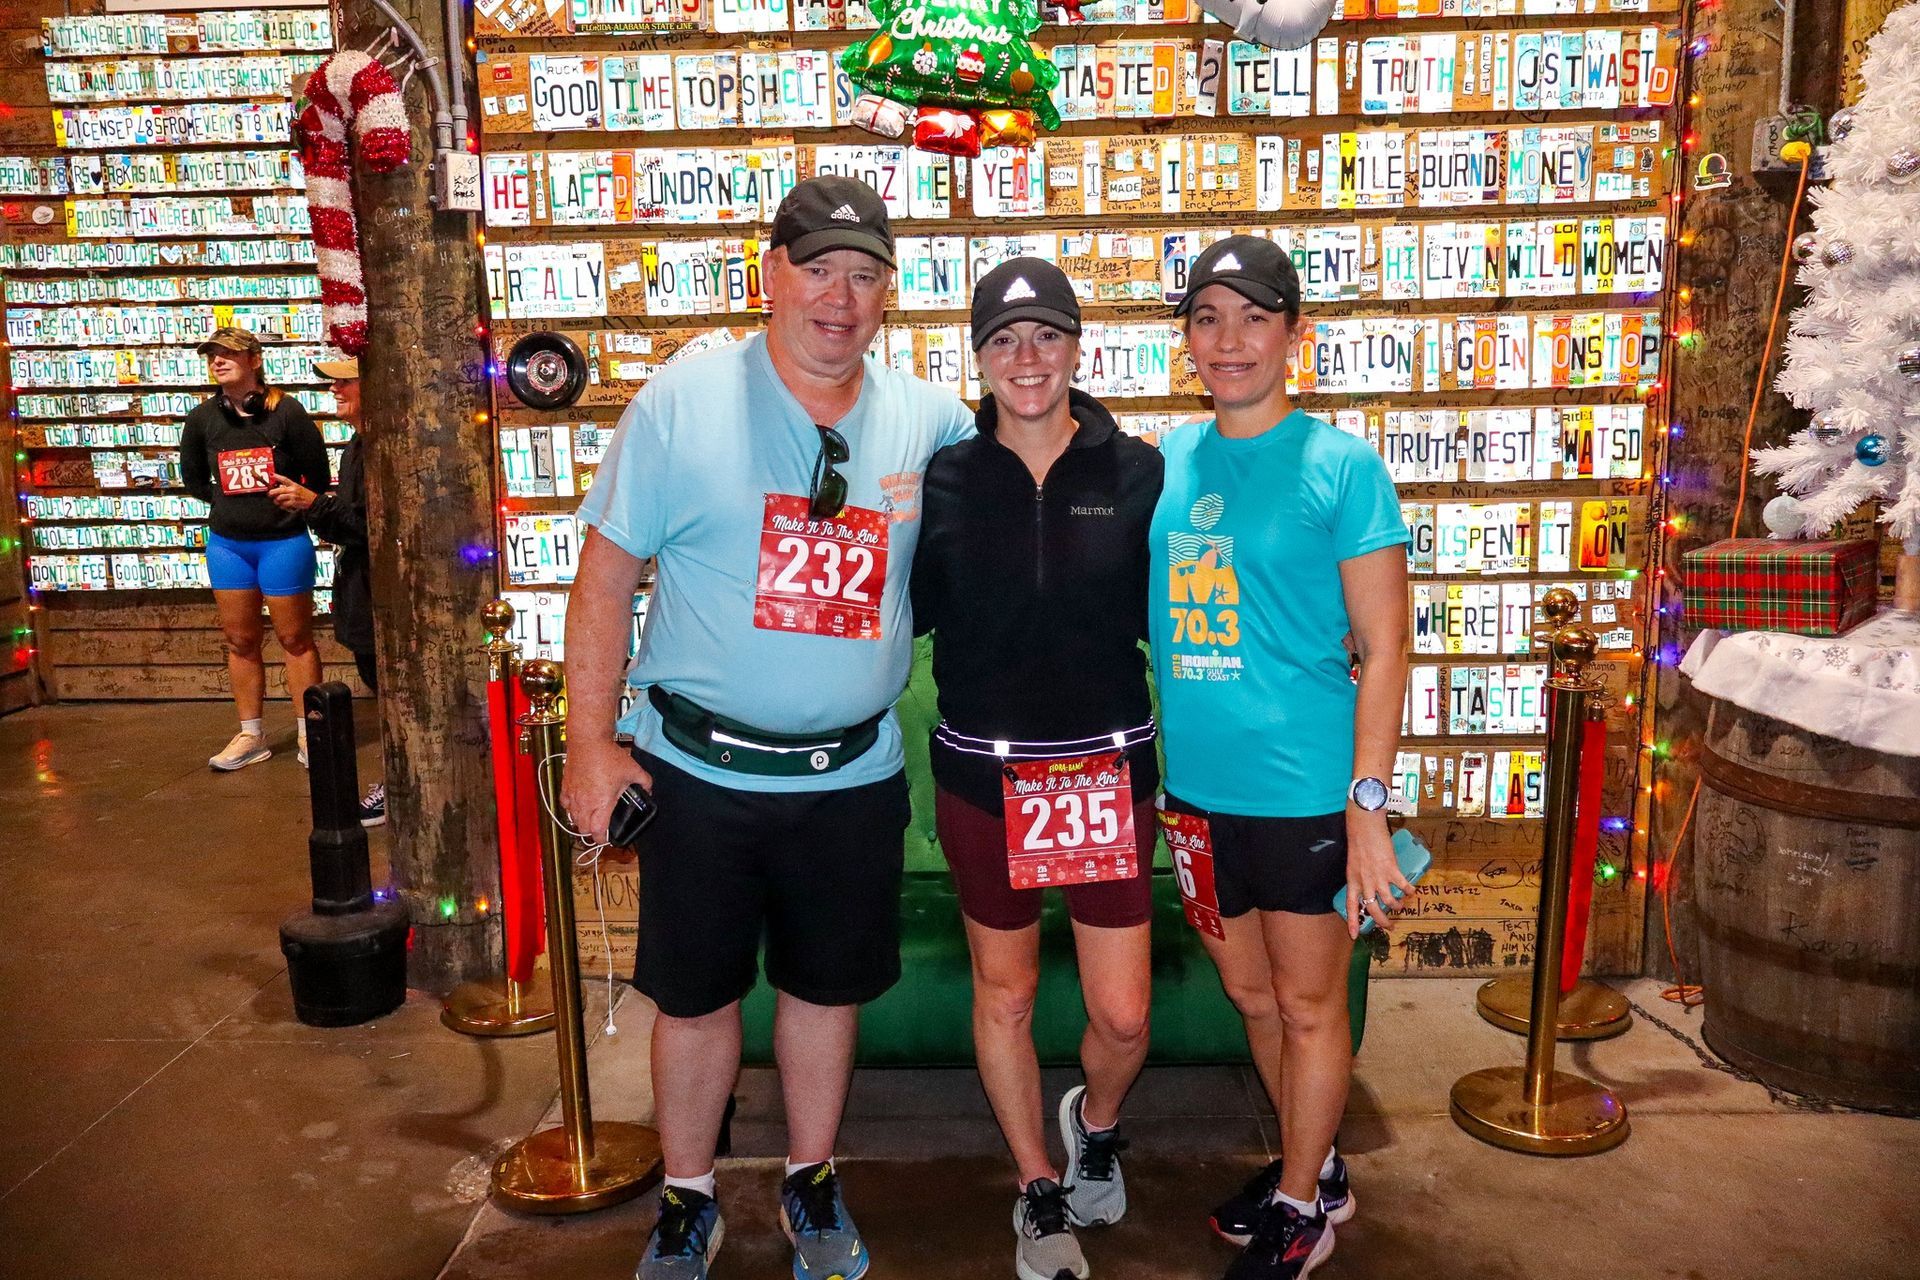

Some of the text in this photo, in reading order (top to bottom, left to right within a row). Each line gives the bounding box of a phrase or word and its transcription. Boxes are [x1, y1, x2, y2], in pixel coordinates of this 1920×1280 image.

[581, 22, 693, 33] FLORIDA-ALABAMA STATE LINE
[891, 6, 1013, 45] Christmas
[534, 75, 598, 118] GOOD
[609, 76, 670, 113] TIME
[683, 74, 735, 111] TOP
[743, 70, 828, 107] SHELF
[1059, 60, 1169, 100] TASTED
[1199, 57, 1309, 97] 2 TELL
[1372, 56, 1455, 96] TRUTH
[917, 165, 949, 201] HE
[983, 161, 1044, 200] YEAH
[1423, 147, 1590, 187] BURND MONEY
[492, 174, 529, 210] HE
[551, 170, 628, 208] LAFFD
[1110, 182, 1141, 194] MADE
[831, 211, 860, 223] adidas
[1387, 240, 1662, 281] HI LIVIN WILD WOMEN
[510, 261, 600, 302] REALLY
[648, 261, 723, 298] WORRY
[616, 336, 650, 349] KEPT
[1457, 333, 1526, 371] GOIN
[1386, 432, 1458, 470] TRUTH
[1473, 431, 1531, 464] REST
[226, 464, 269, 490] 285
[1070, 505, 1114, 516] Marmot
[772, 514, 879, 545] Make It To The Line
[1453, 523, 1530, 558] SPENT
[1541, 523, 1569, 556] IT
[1594, 523, 1626, 557] ON
[507, 534, 570, 568] YEAH
[774, 537, 874, 603] 232
[1169, 608, 1241, 647] 70.3
[1417, 601, 1496, 637] WHERE
[1505, 603, 1531, 635] IT
[1206, 673, 1229, 681] COAST
[1014, 772, 1119, 796] Make It To The Line
[1021, 791, 1118, 851] 235
[1173, 830, 1187, 845] The
[1189, 834, 1206, 850] Line
[1174, 848, 1197, 899] 6
[811, 1163, 831, 1186] HOKA
